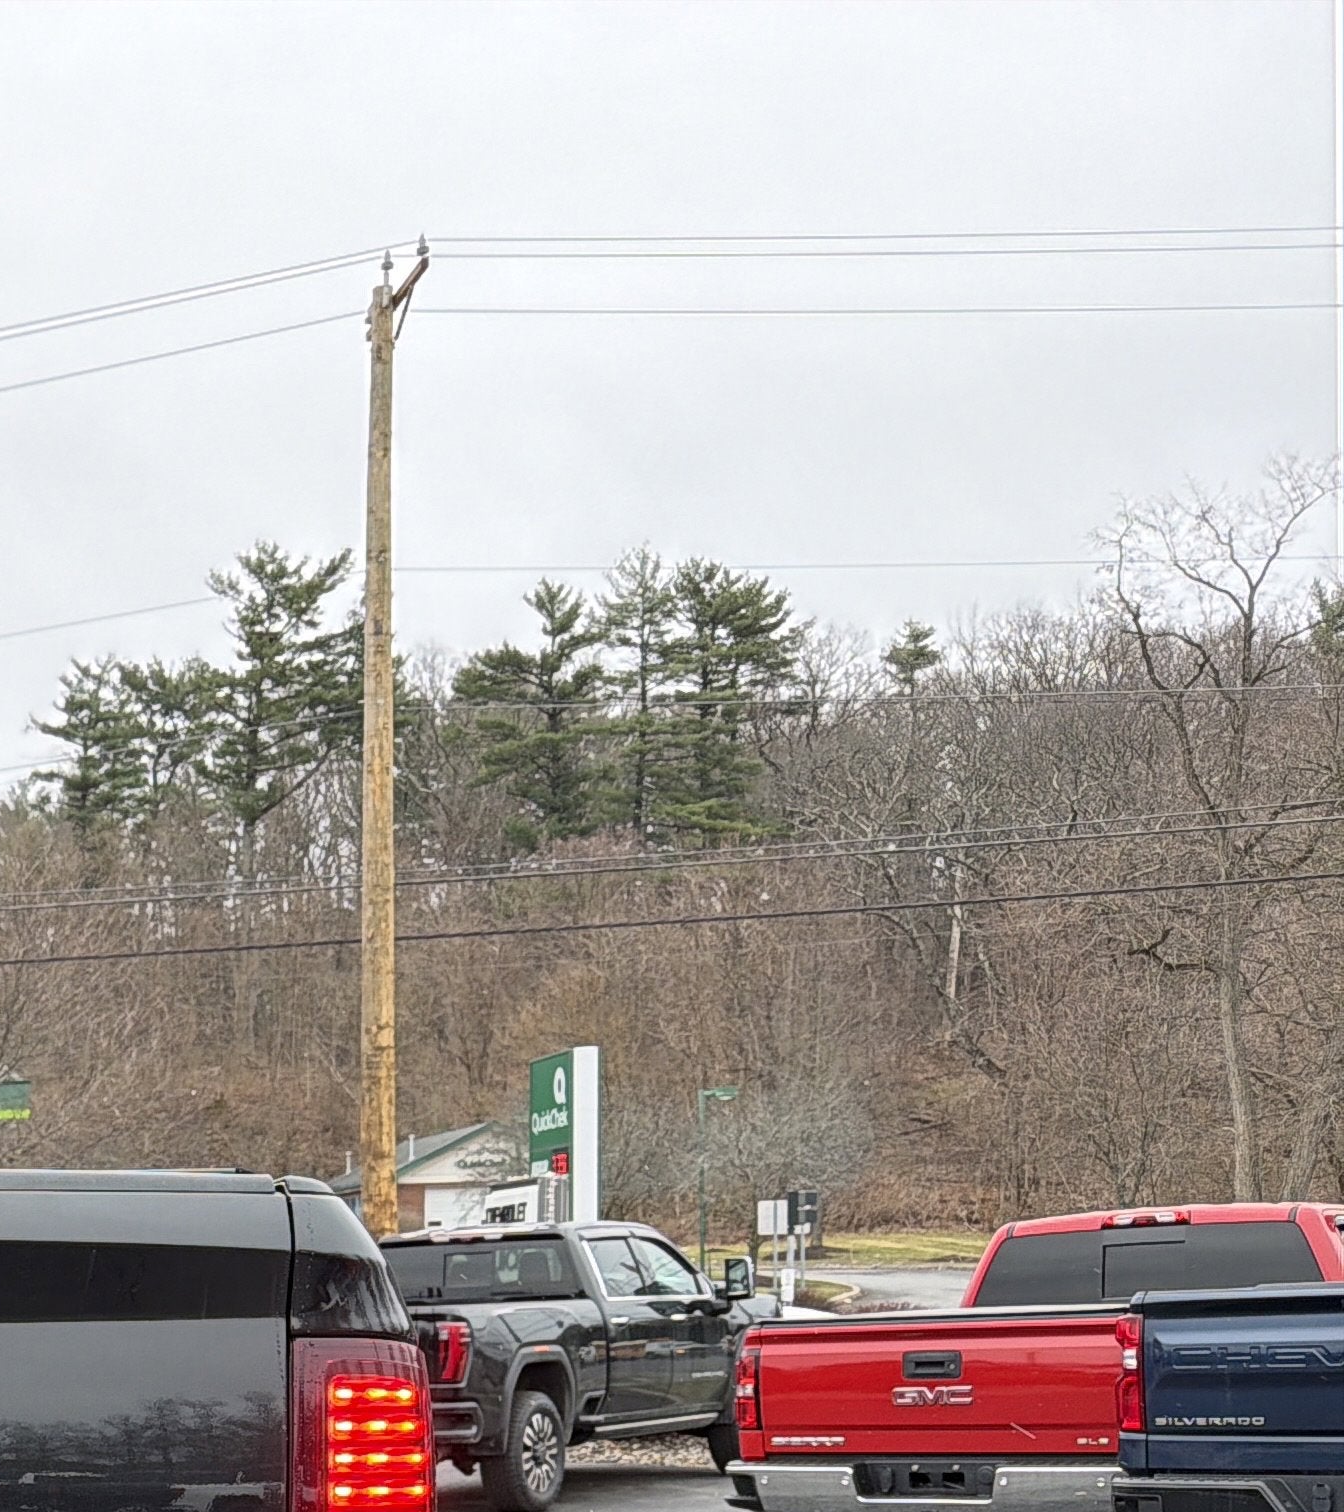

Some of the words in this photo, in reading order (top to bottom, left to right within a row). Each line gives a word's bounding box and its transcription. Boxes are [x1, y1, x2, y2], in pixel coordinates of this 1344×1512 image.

[532, 1108, 568, 1135] QuickChek
[891, 1385, 973, 1407] GMC
[1154, 1416, 1266, 1427] SILVERADO
